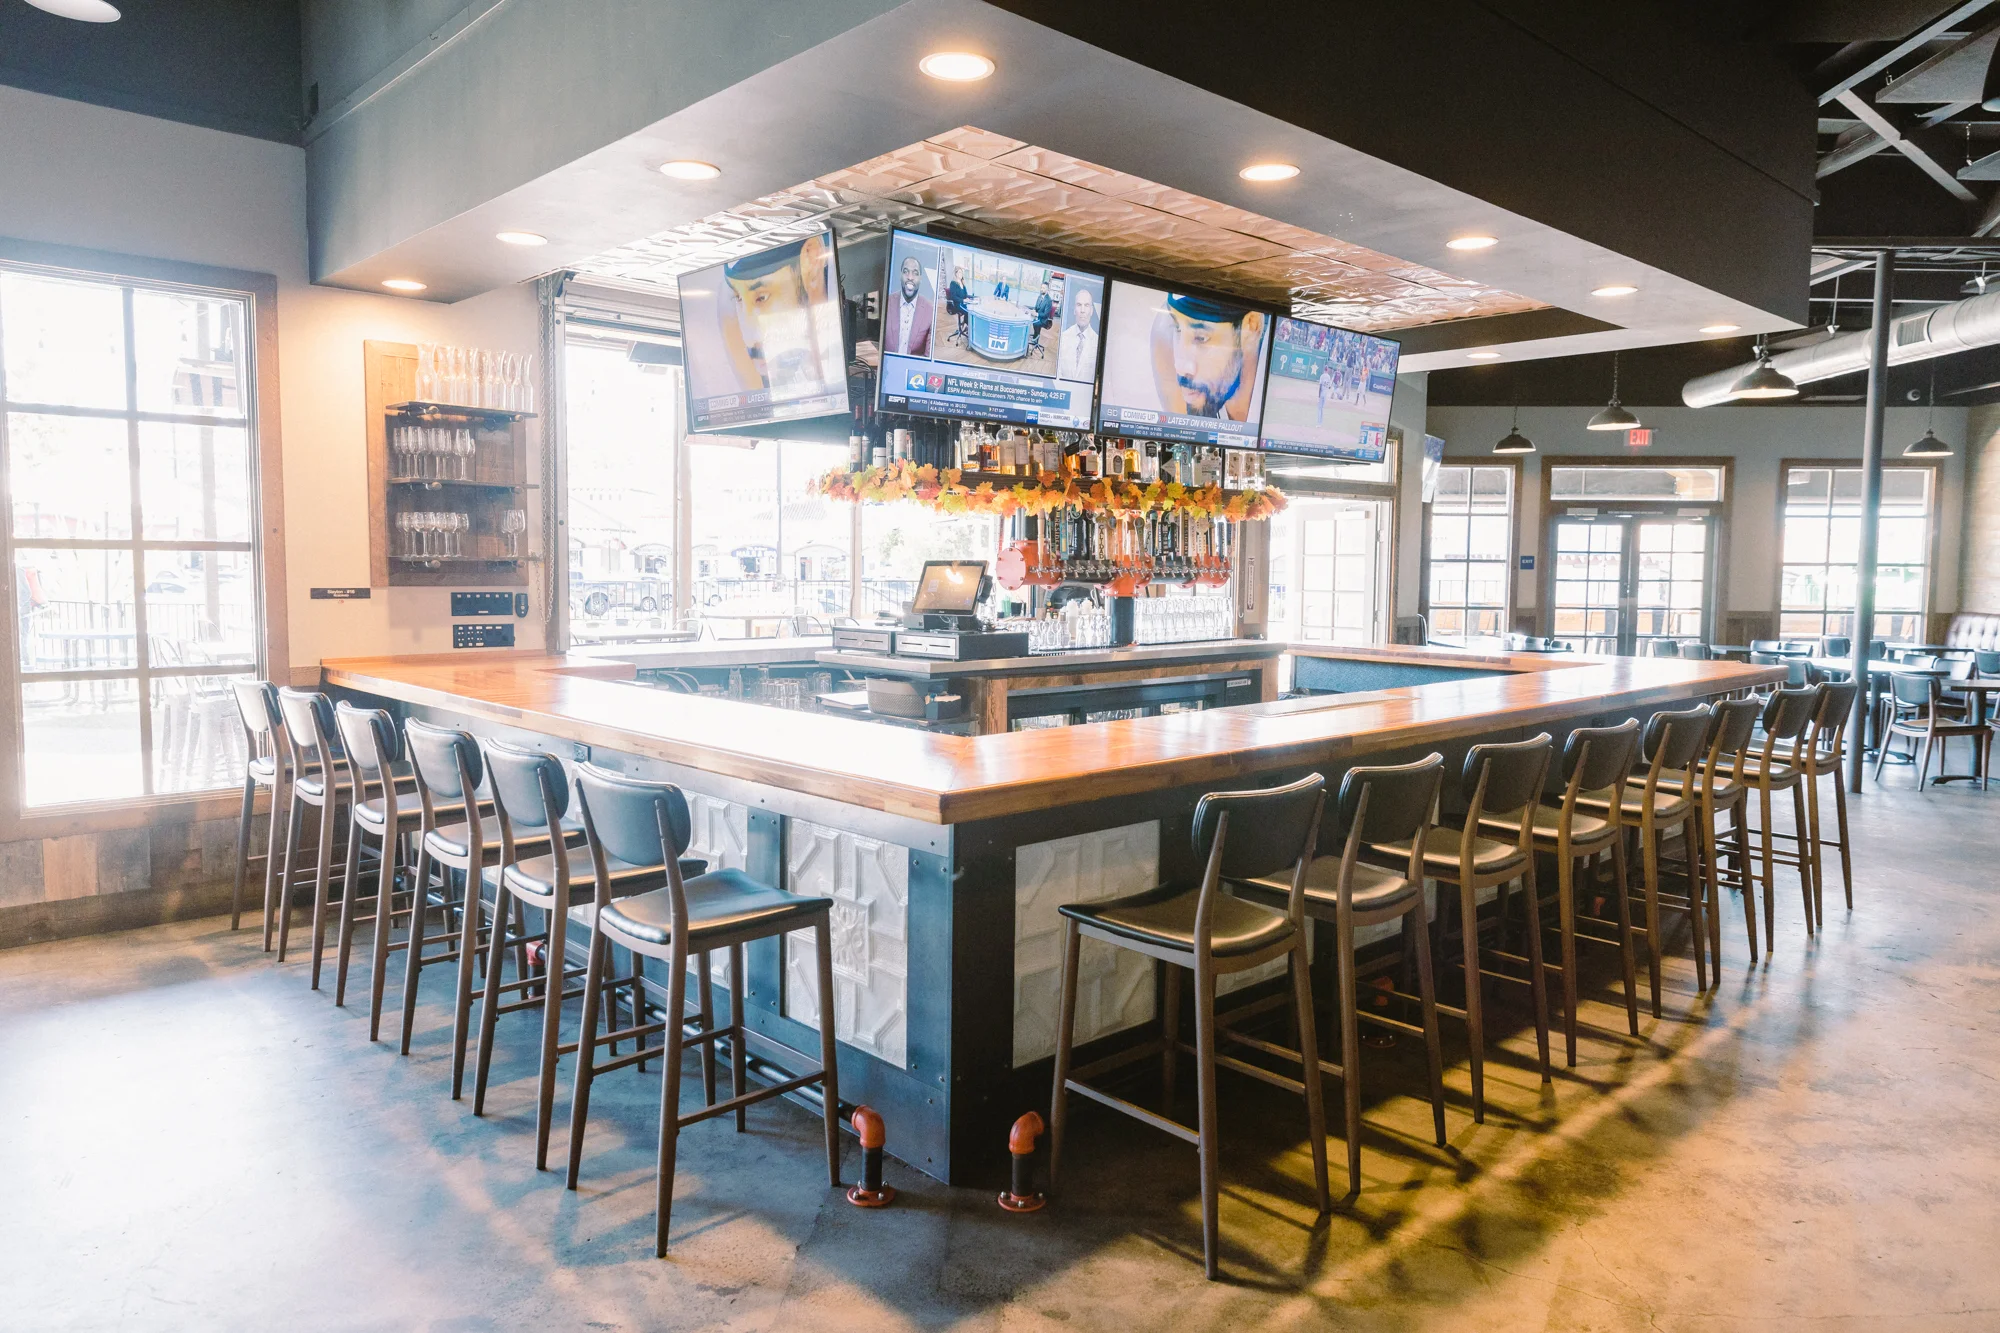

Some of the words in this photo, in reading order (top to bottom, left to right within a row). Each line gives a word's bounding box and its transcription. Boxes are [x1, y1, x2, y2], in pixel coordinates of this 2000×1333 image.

[991, 340, 1006, 349] IN
[947, 378, 958, 386] NFL
[959, 379, 973, 389] Week
[973, 381, 979, 389] 9:
[979, 382, 993, 391] Rams
[994, 384, 999, 392] at
[1000, 385, 1027, 395] Buccaneers
[1031, 388, 1048, 399] Sunday,
[1049, 391, 1059, 399] 4:25
[747, 392, 768, 403] LATEST
[888, 395, 906, 404] ESPN
[961, 388, 981, 397] Analytics:
[982, 391, 1006, 399] Buccaneers
[1016, 395, 1030, 403] chance
[710, 398, 729, 409] COMING
[730, 397, 737, 405] UP
[1123, 410, 1147, 420] COMING
[1147, 413, 1156, 421] UP
[1167, 416, 1190, 426] LATEST
[1190, 419, 1200, 427] ON
[1200, 420, 1218, 429] KYRIE
[1218, 423, 1243, 432] FALLOUT
[1630, 429, 1650, 445] EXIT
